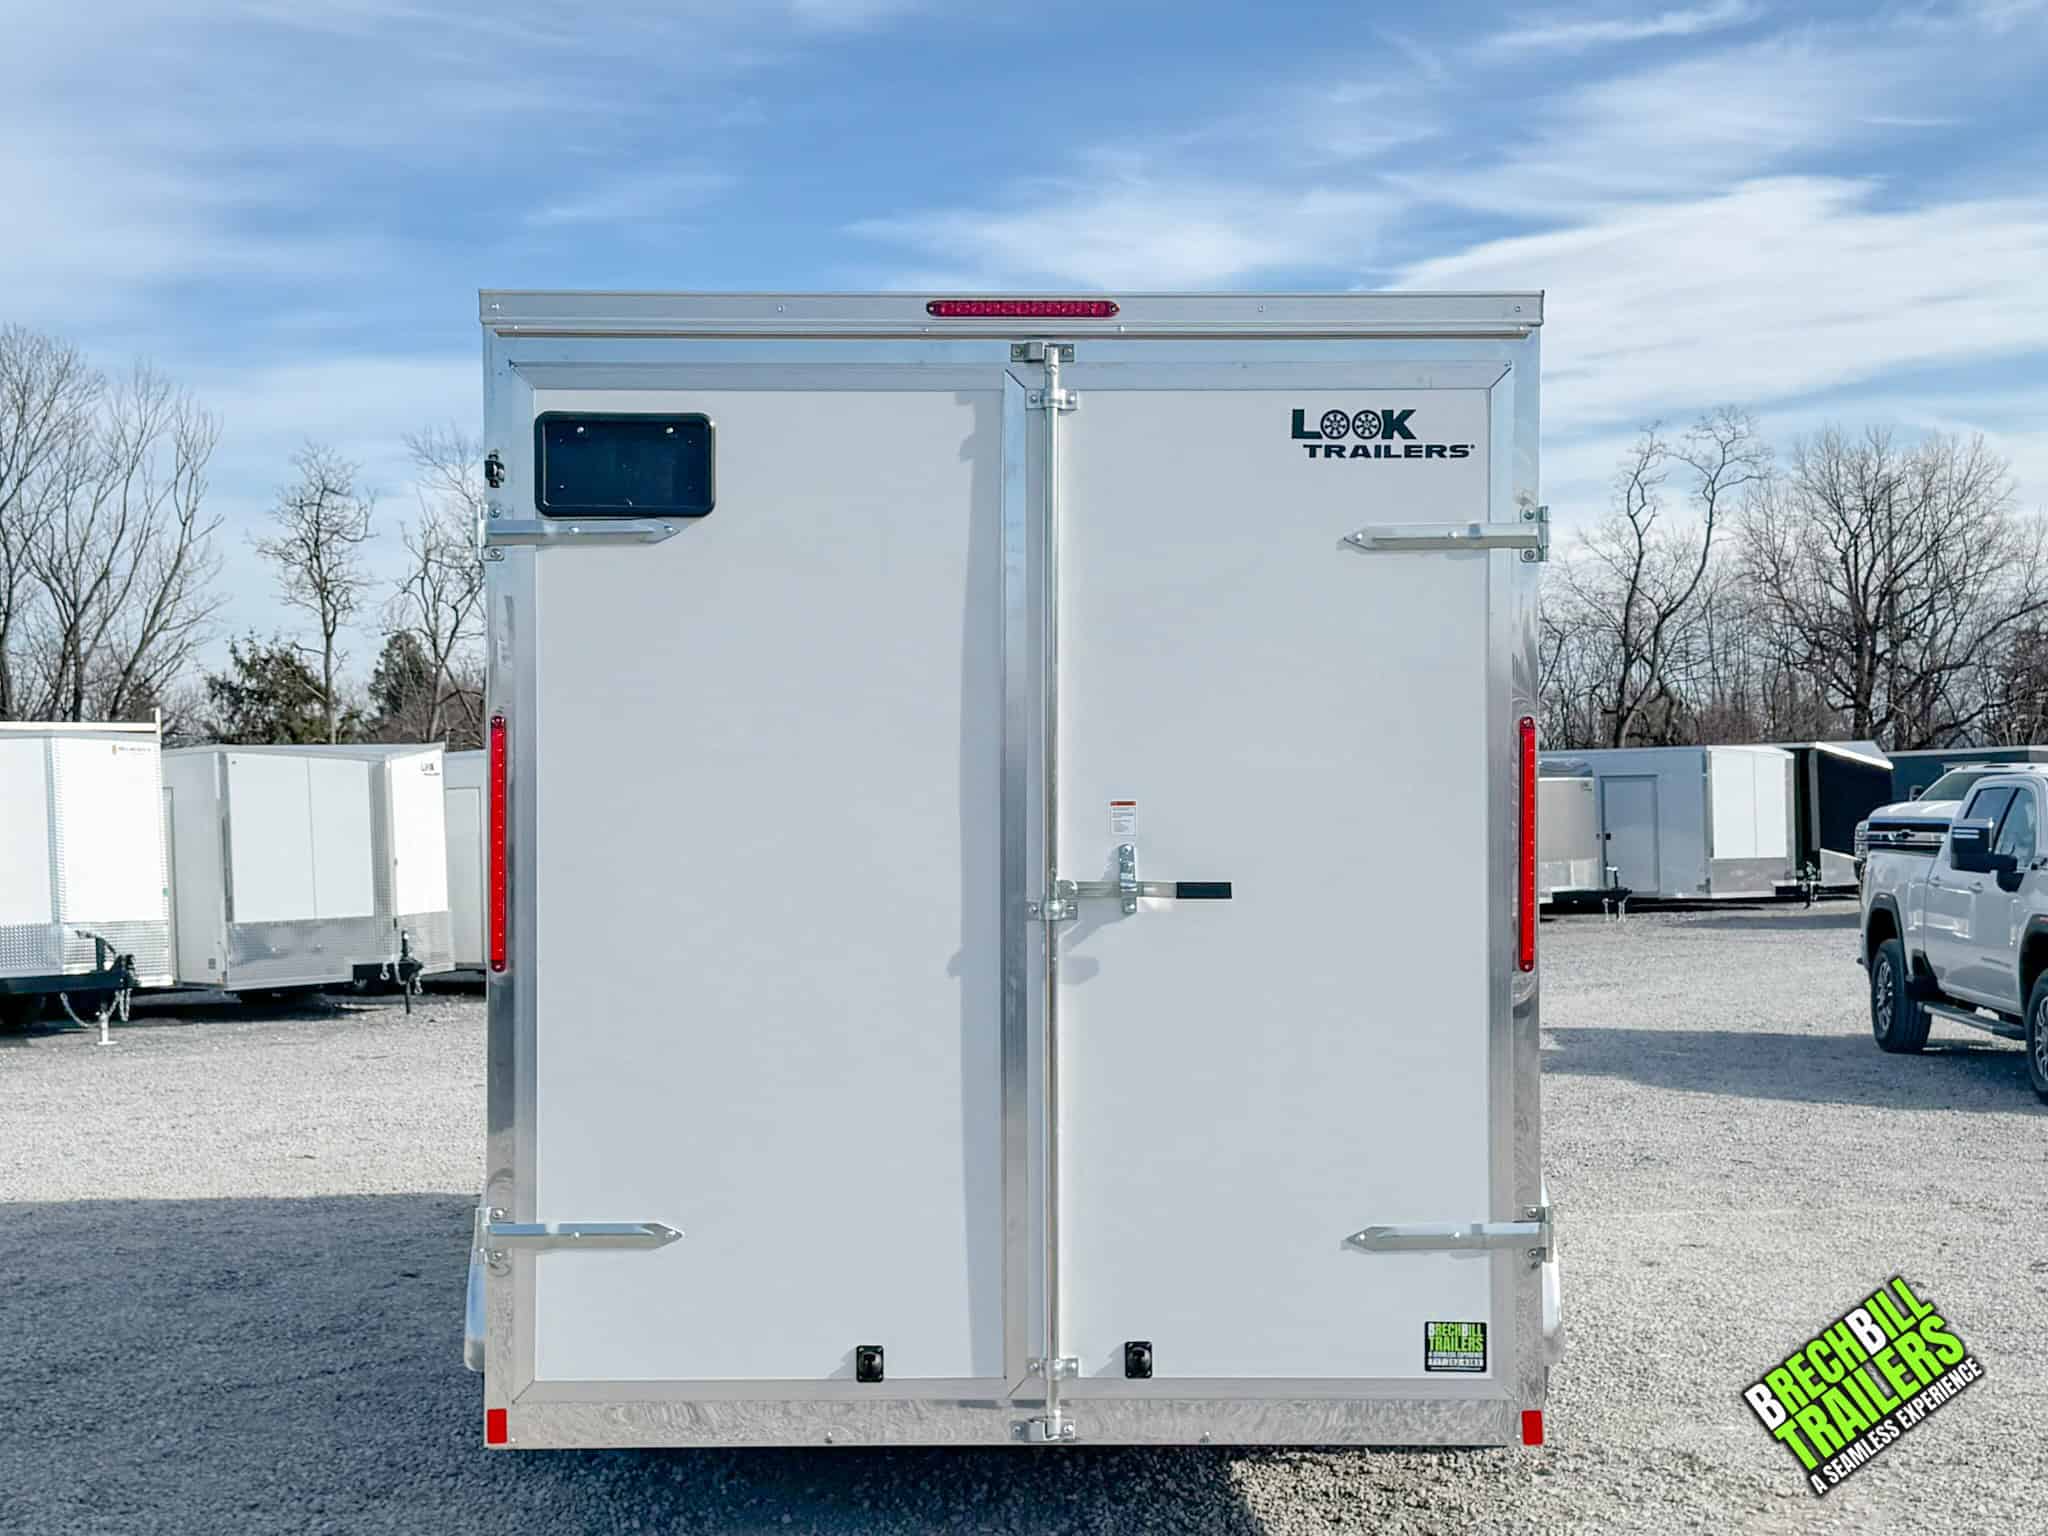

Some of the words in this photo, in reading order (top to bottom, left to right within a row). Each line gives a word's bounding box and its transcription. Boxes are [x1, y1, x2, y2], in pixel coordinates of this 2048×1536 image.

[1291, 408, 1417, 439] LOOK
[1303, 444, 1475, 458] TRAILERS
[1428, 1336, 1484, 1351] TRAILERS
